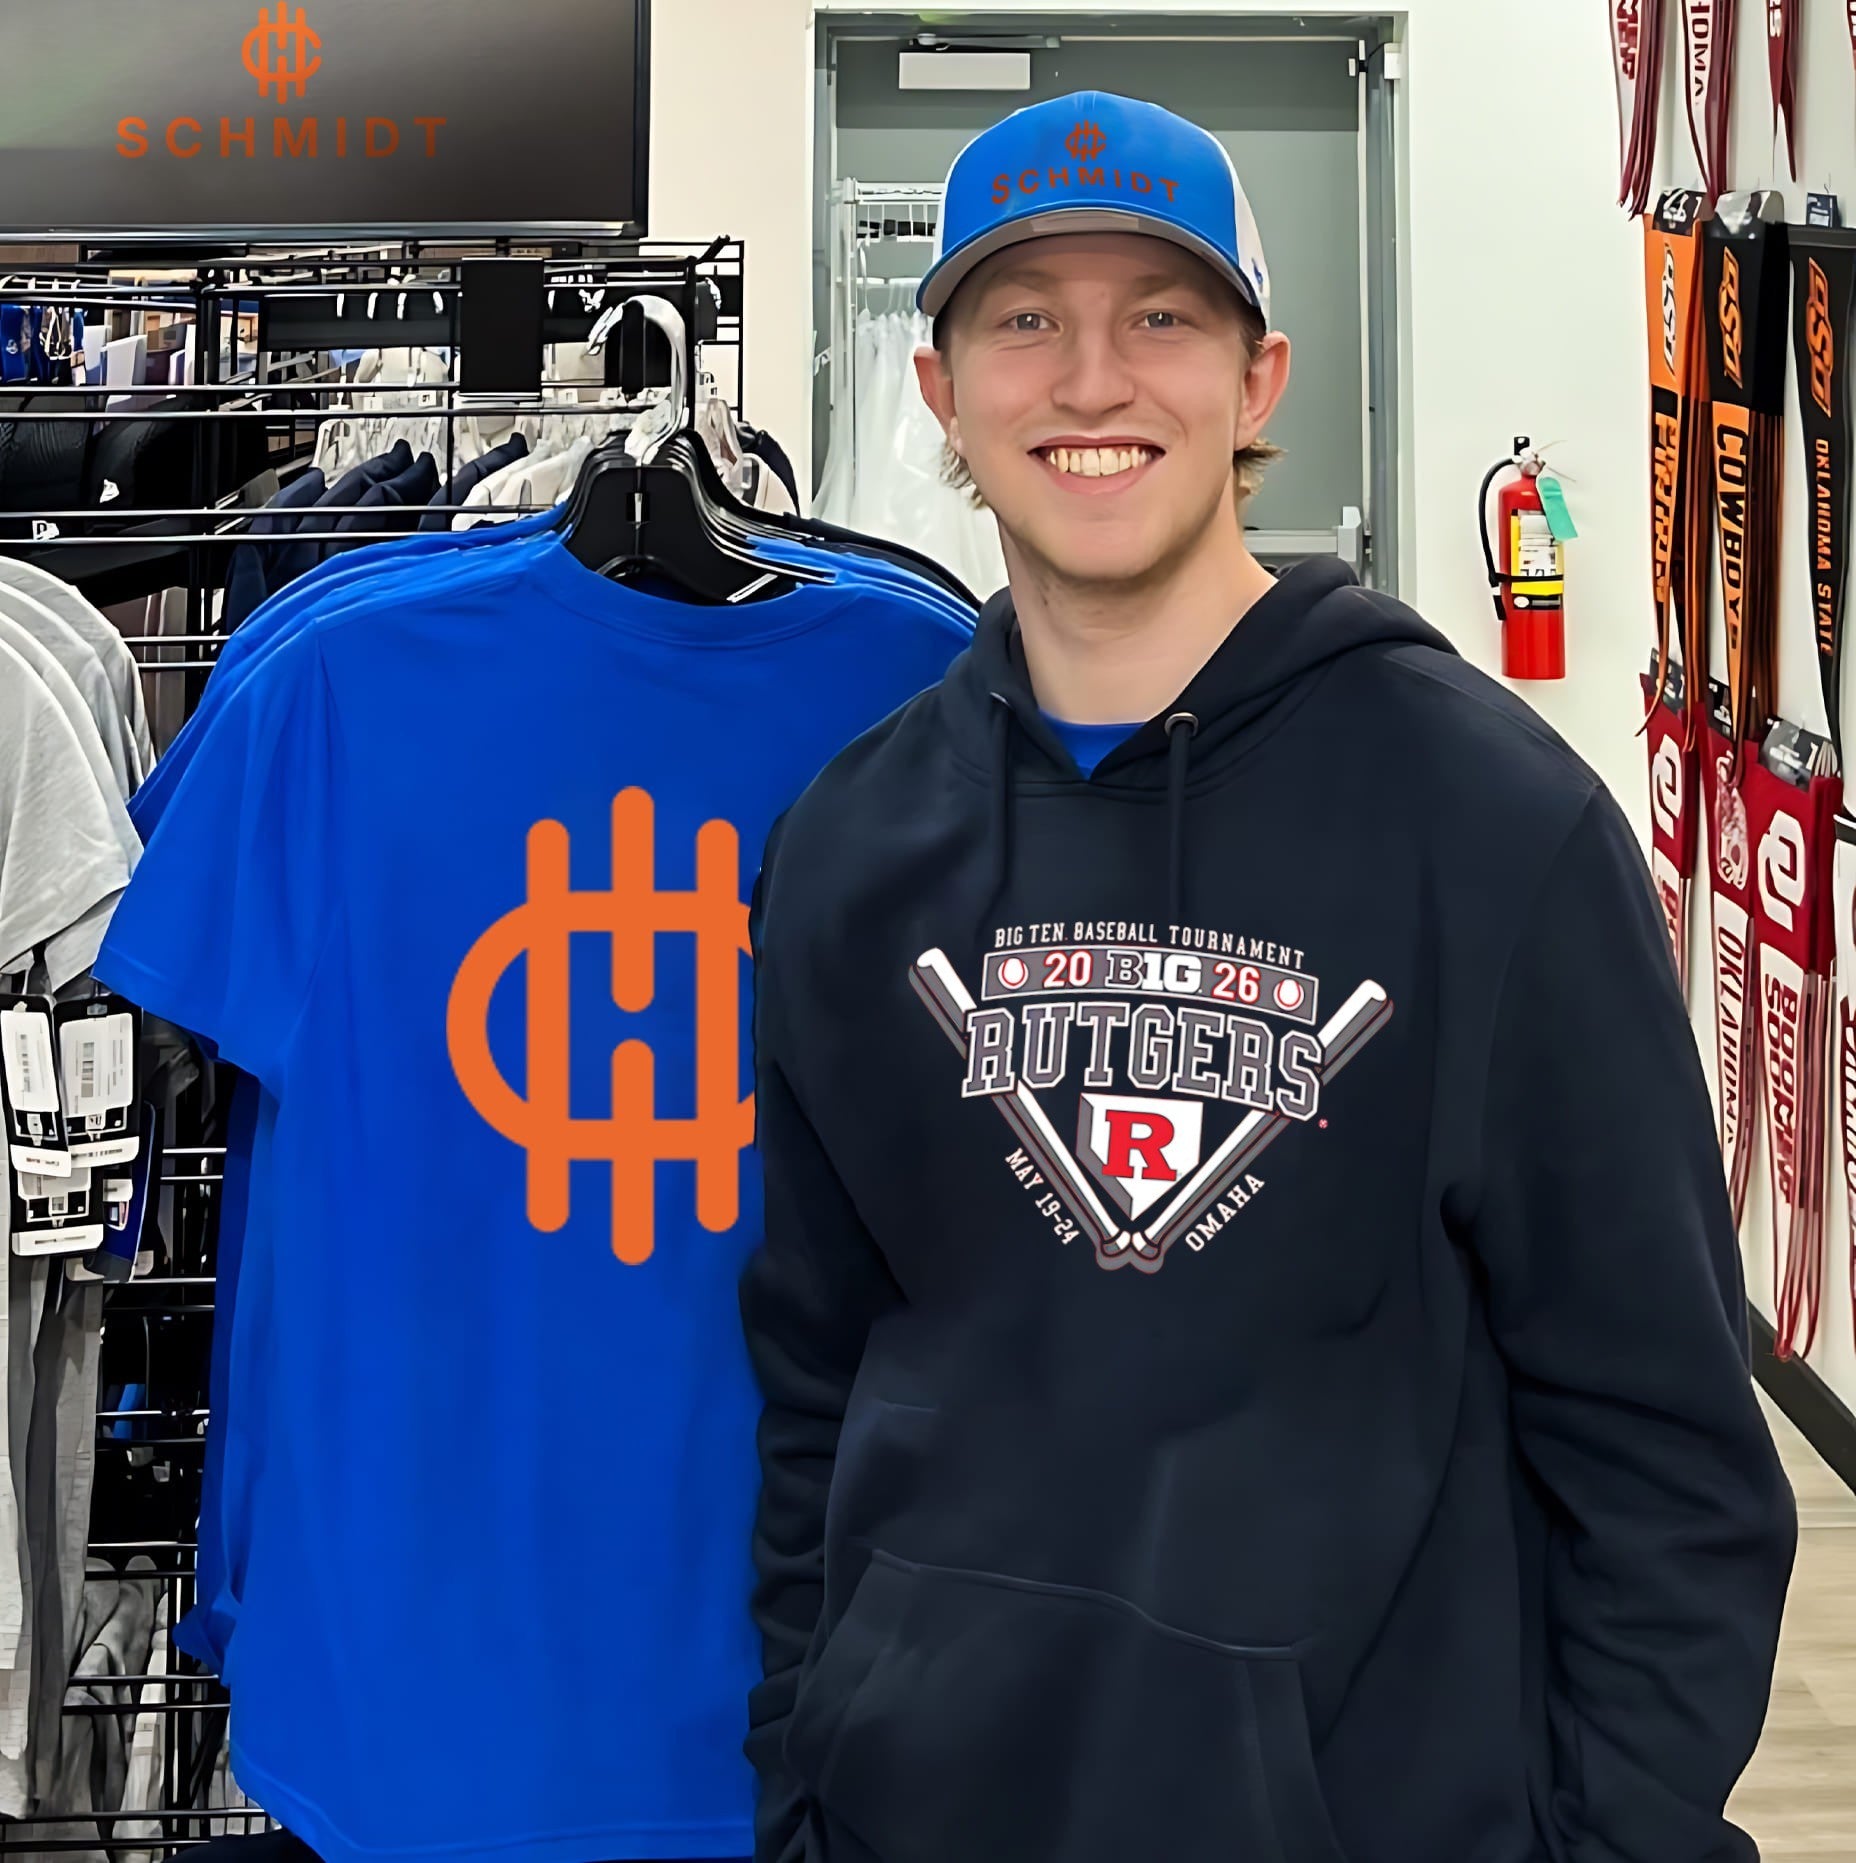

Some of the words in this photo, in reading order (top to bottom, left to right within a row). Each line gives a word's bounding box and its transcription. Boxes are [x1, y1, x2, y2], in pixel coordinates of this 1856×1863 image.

[115, 116, 448, 158] SCHMIDT
[991, 166, 1180, 205] SCHMIDT
[1815, 438, 1833, 570] OKLAHOMA
[994, 926, 1023, 948] BIG
[1029, 922, 1065, 944] TEN
[1073, 921, 1158, 943] BASEBALL
[1168, 925, 1305, 970] TOURNAMENT
[1042, 950, 1094, 989] 20
[1211, 961, 1261, 1004] 26
[961, 1001, 1322, 1121] RUTGERS
[1101, 1109, 1178, 1182] R
[1005, 1147, 1044, 1190] MAY
[1034, 1192, 1080, 1245] 19-24
[1184, 1173, 1265, 1252] OMAHA
